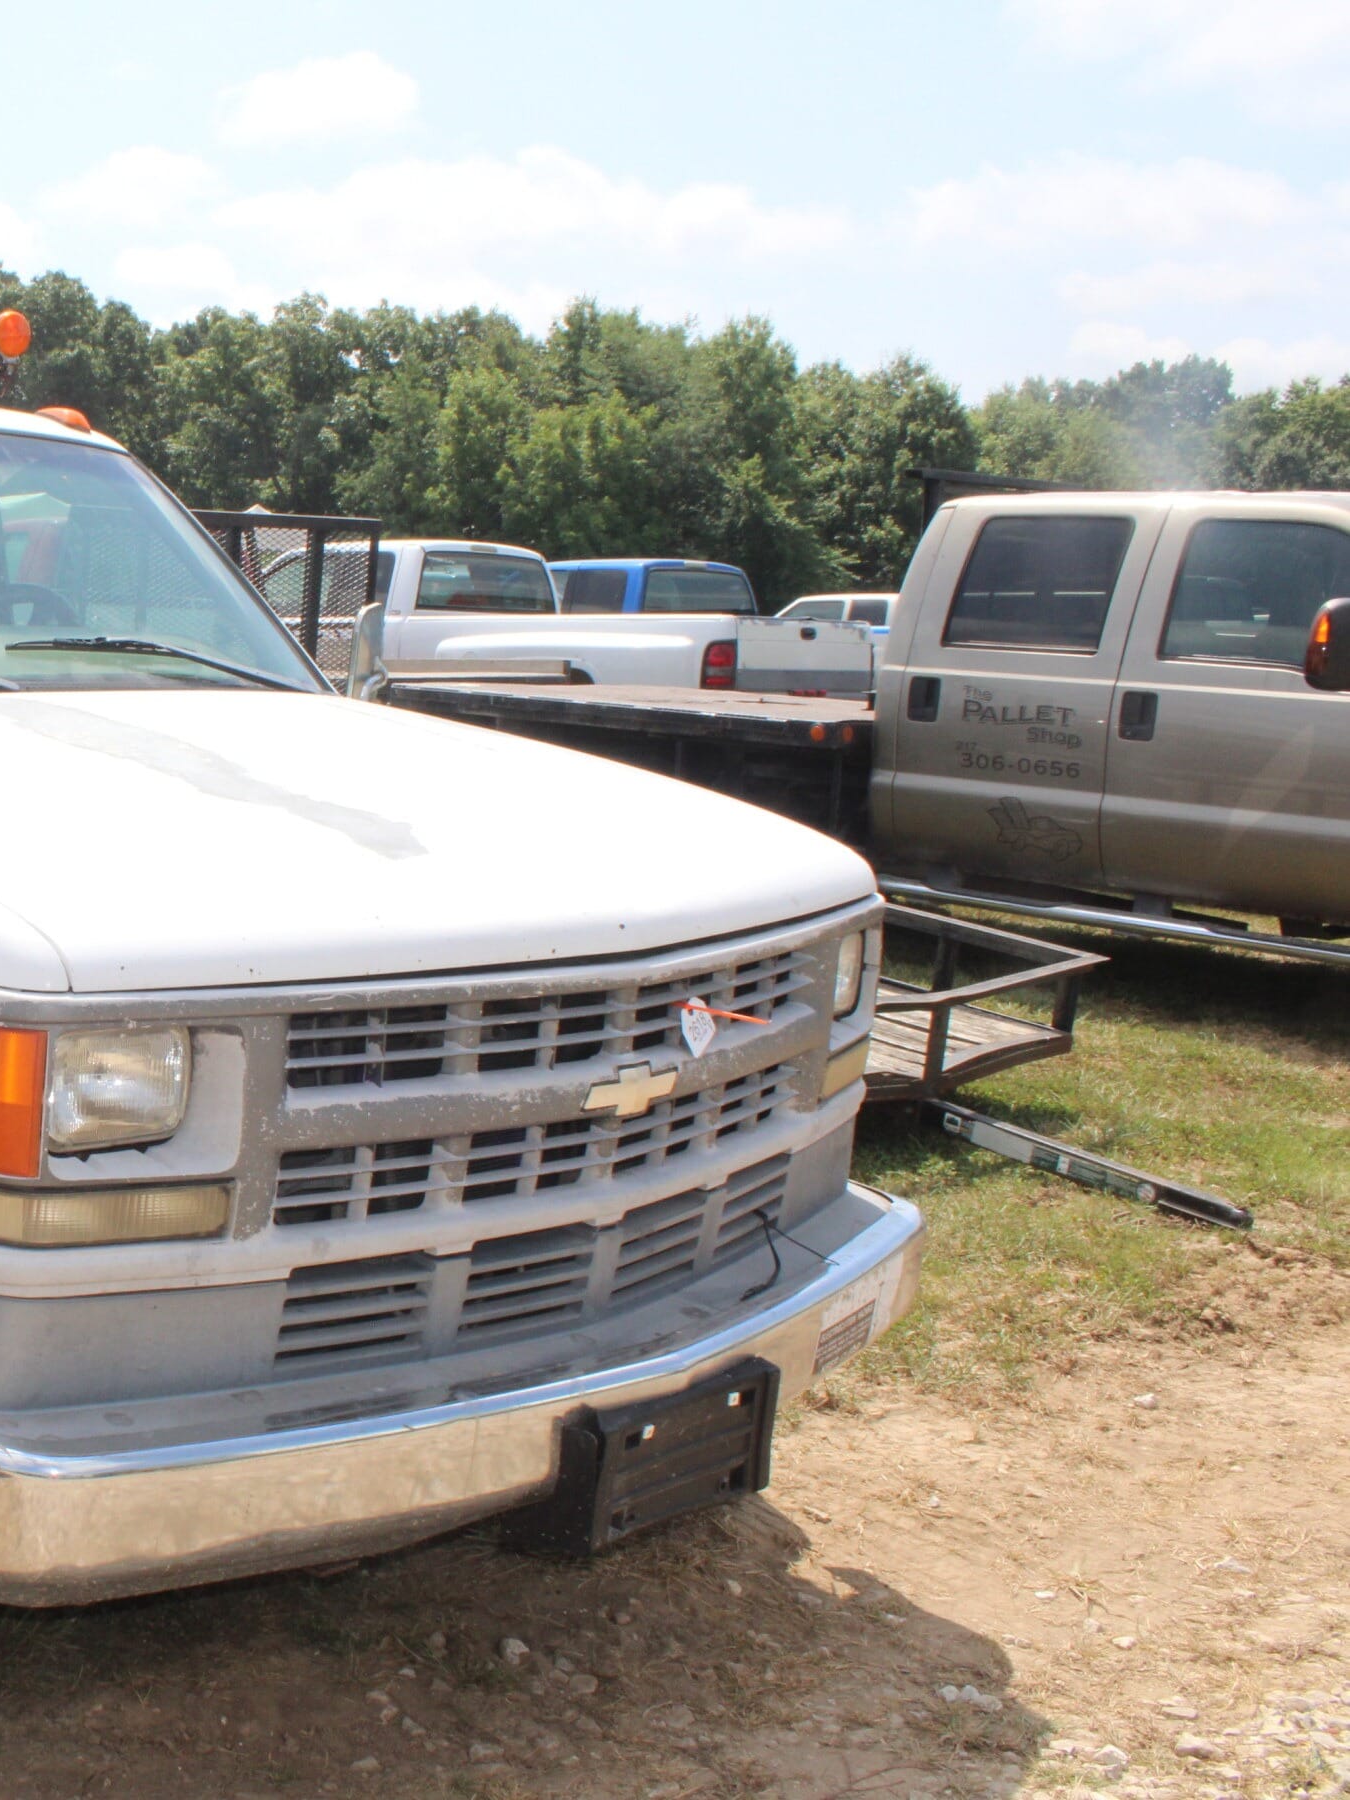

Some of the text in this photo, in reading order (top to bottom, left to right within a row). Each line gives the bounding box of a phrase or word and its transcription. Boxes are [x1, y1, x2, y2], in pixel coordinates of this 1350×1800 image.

[965, 686, 992, 700] The
[963, 700, 1075, 727] PALLET
[1026, 726, 1082, 749] Shop
[960, 752, 1080, 778] 306-0656
